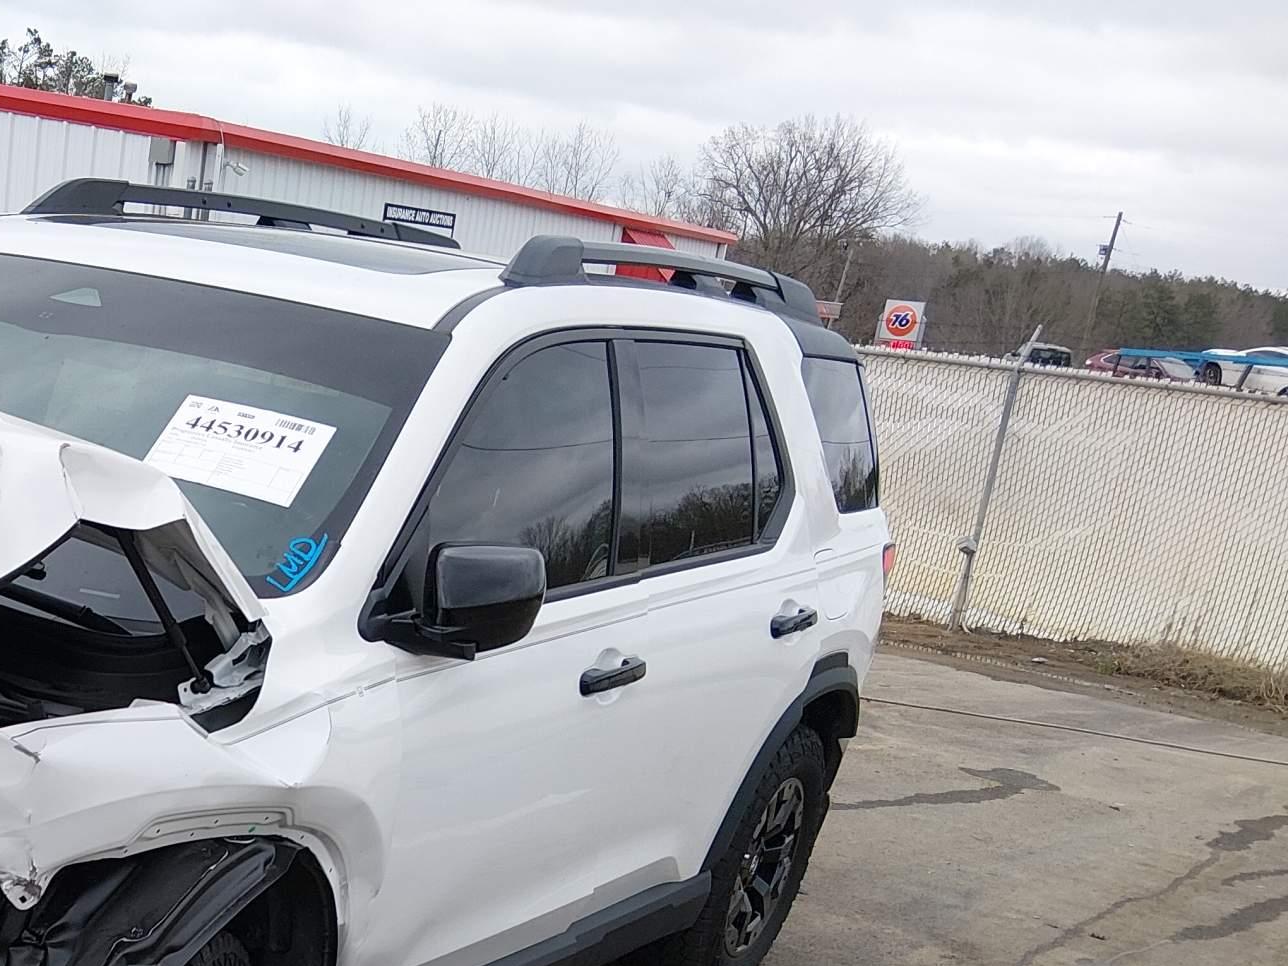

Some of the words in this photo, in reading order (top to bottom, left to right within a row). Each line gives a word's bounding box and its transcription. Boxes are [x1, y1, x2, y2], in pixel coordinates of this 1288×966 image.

[388, 207, 415, 220] INSURANCE
[416, 210, 429, 223] AUTO
[430, 212, 453, 226] AUCTIONS
[889, 312, 913, 329] 76
[185, 415, 305, 453] 44530914
